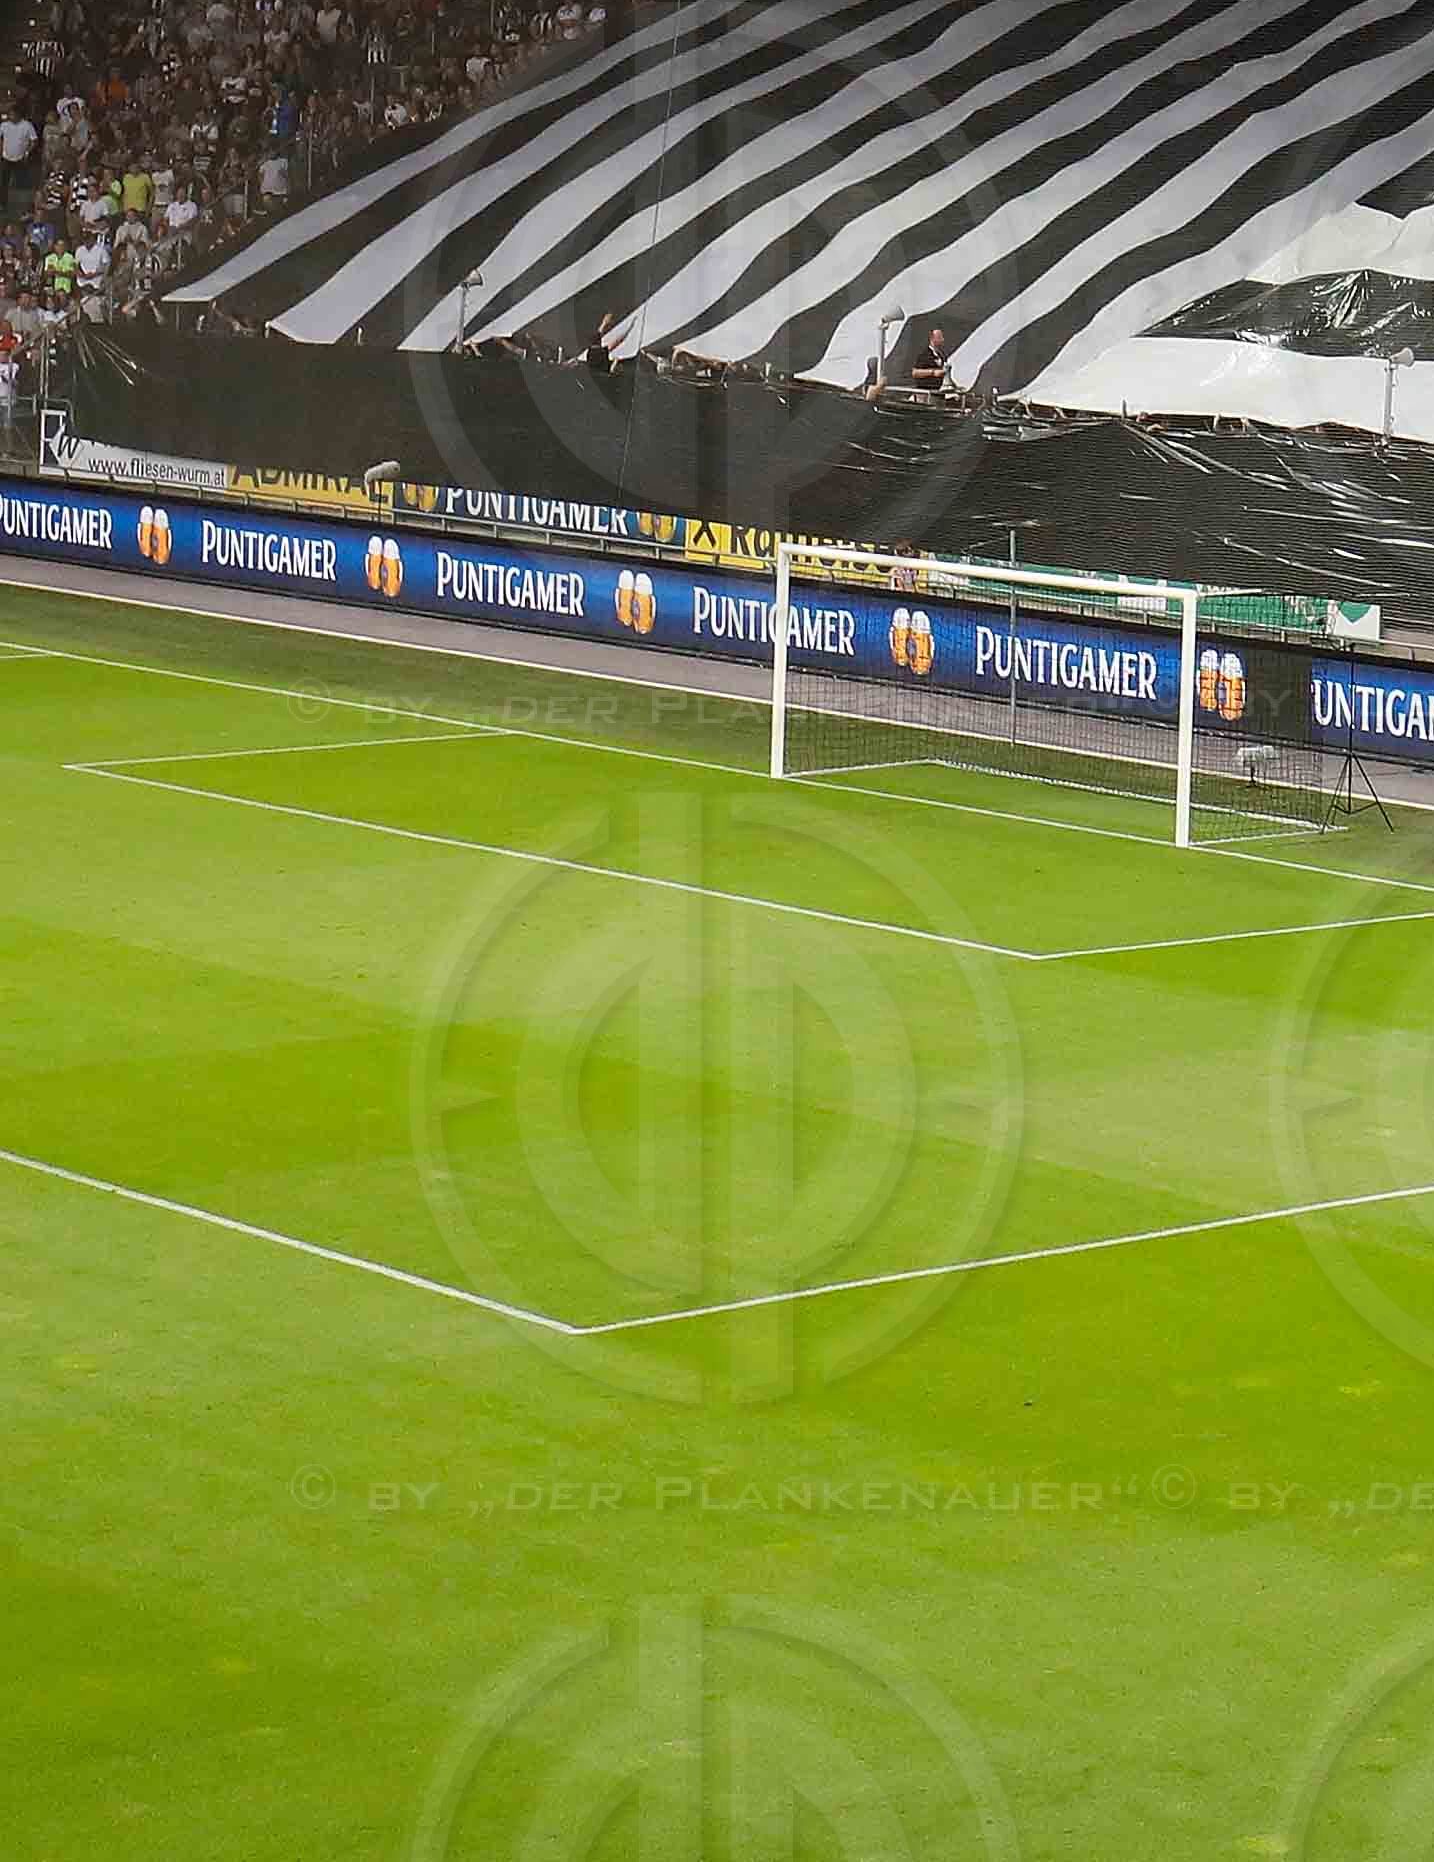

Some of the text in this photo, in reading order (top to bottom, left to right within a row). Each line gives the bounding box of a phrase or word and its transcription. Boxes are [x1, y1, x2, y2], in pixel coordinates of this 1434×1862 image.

[88, 458, 225, 486] www.fliesen-wurm.at
[202, 519, 337, 582] PUNTIGAMER
[436, 552, 585, 617] PUNTIGAMER
[976, 627, 1157, 700] PUNTIGAMER
